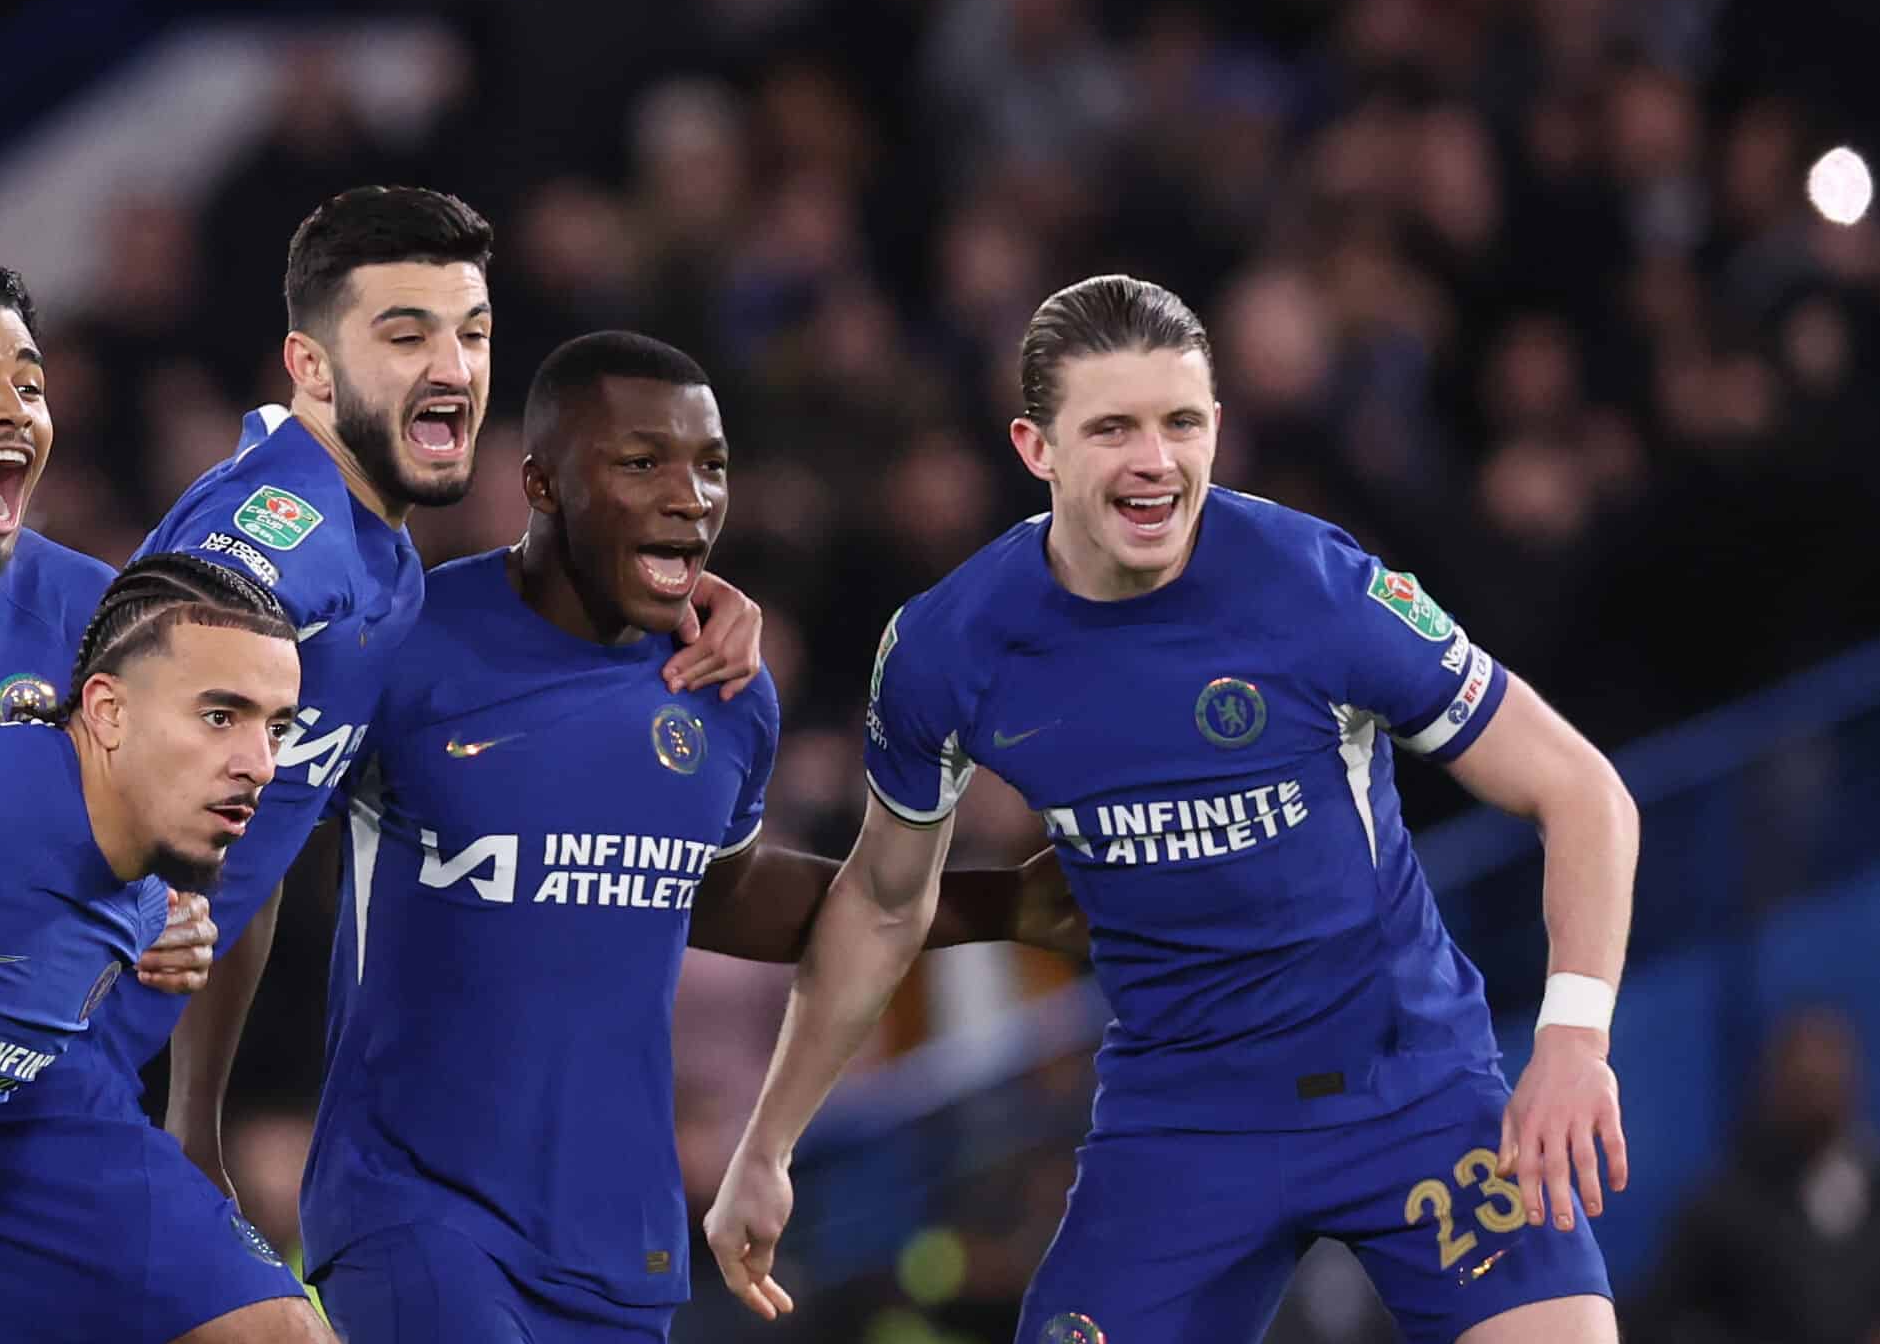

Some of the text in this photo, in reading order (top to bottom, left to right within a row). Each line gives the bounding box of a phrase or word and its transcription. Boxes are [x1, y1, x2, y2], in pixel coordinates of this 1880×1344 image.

[199, 532, 279, 580] No room
[1464, 678, 1482, 703] EFL
[1097, 779, 1301, 835] INFINITE
[1105, 793, 1309, 864] ATHLETE
[1404, 1147, 1528, 1271] 23
